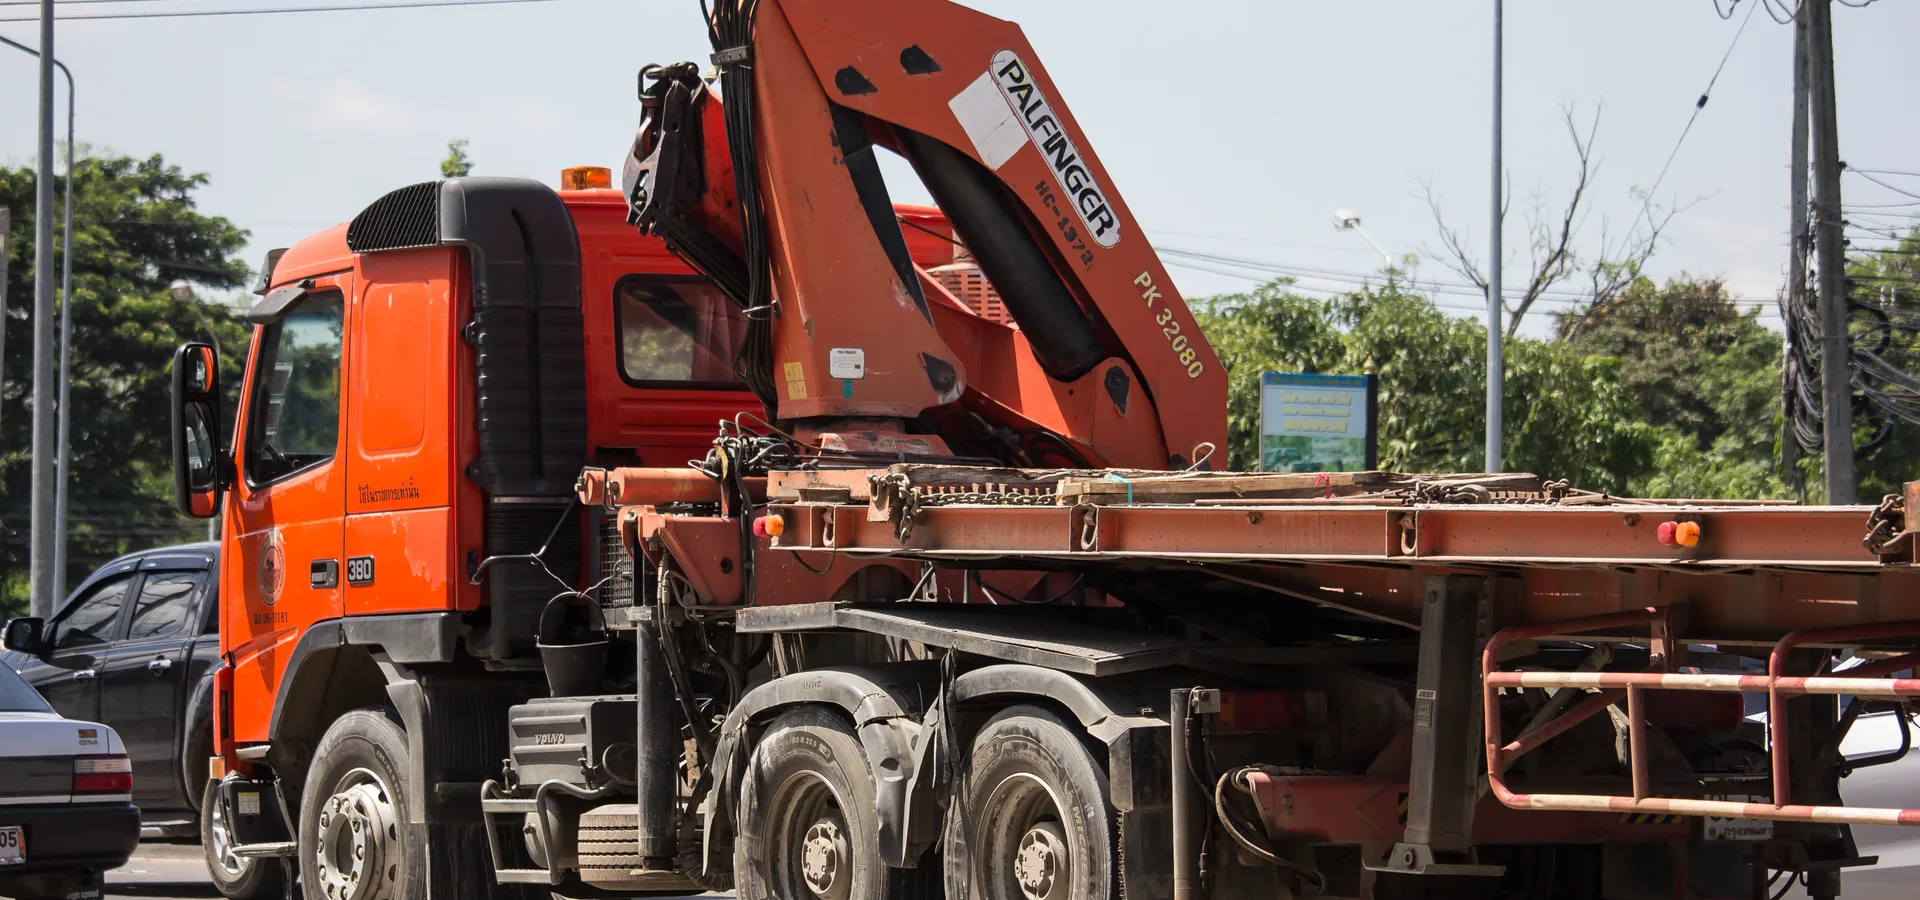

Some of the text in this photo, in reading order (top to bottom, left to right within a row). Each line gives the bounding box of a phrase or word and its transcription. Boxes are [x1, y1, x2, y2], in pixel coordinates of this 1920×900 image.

[998, 59, 1115, 238] PALFINGER
[1133, 271, 1204, 380] PK 32080
[358, 477, 420, 504] ใช้ในราชการเท่านั้น
[348, 559, 372, 581] 380
[535, 733, 565, 745] VOLVO
